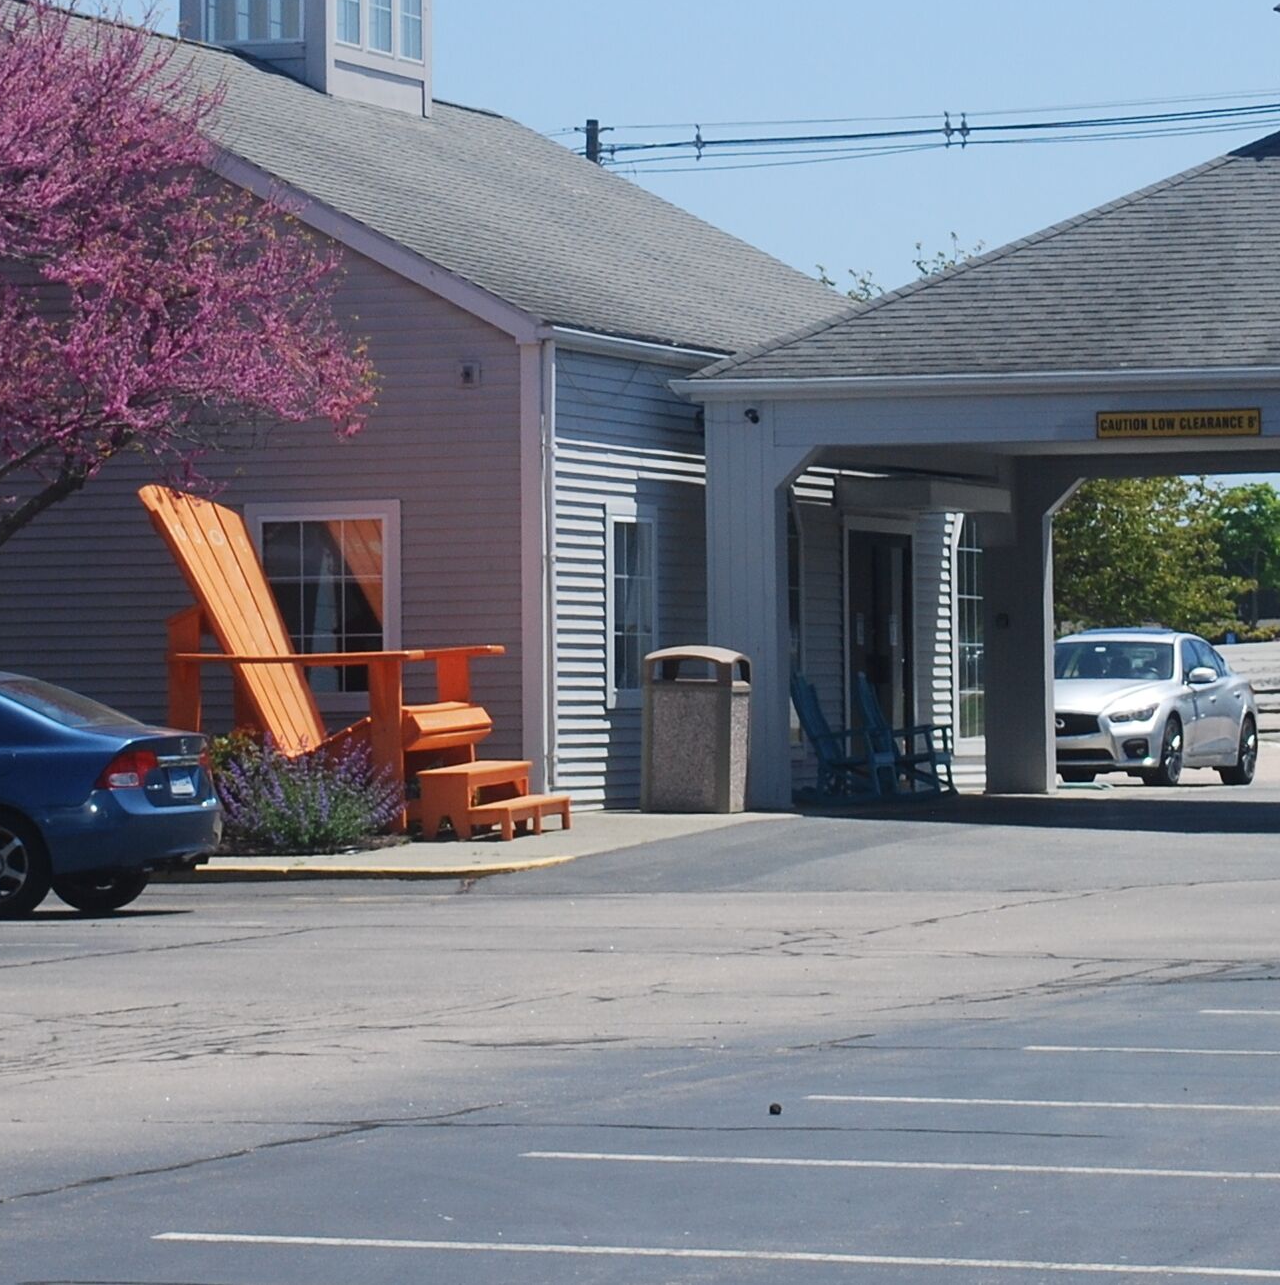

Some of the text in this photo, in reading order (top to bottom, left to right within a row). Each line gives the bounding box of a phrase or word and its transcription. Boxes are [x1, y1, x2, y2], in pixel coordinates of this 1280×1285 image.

[1100, 418, 1148, 431] CAUTION
[1152, 417, 1176, 430] LOW
[1179, 416, 1244, 430] CLEARANCE
